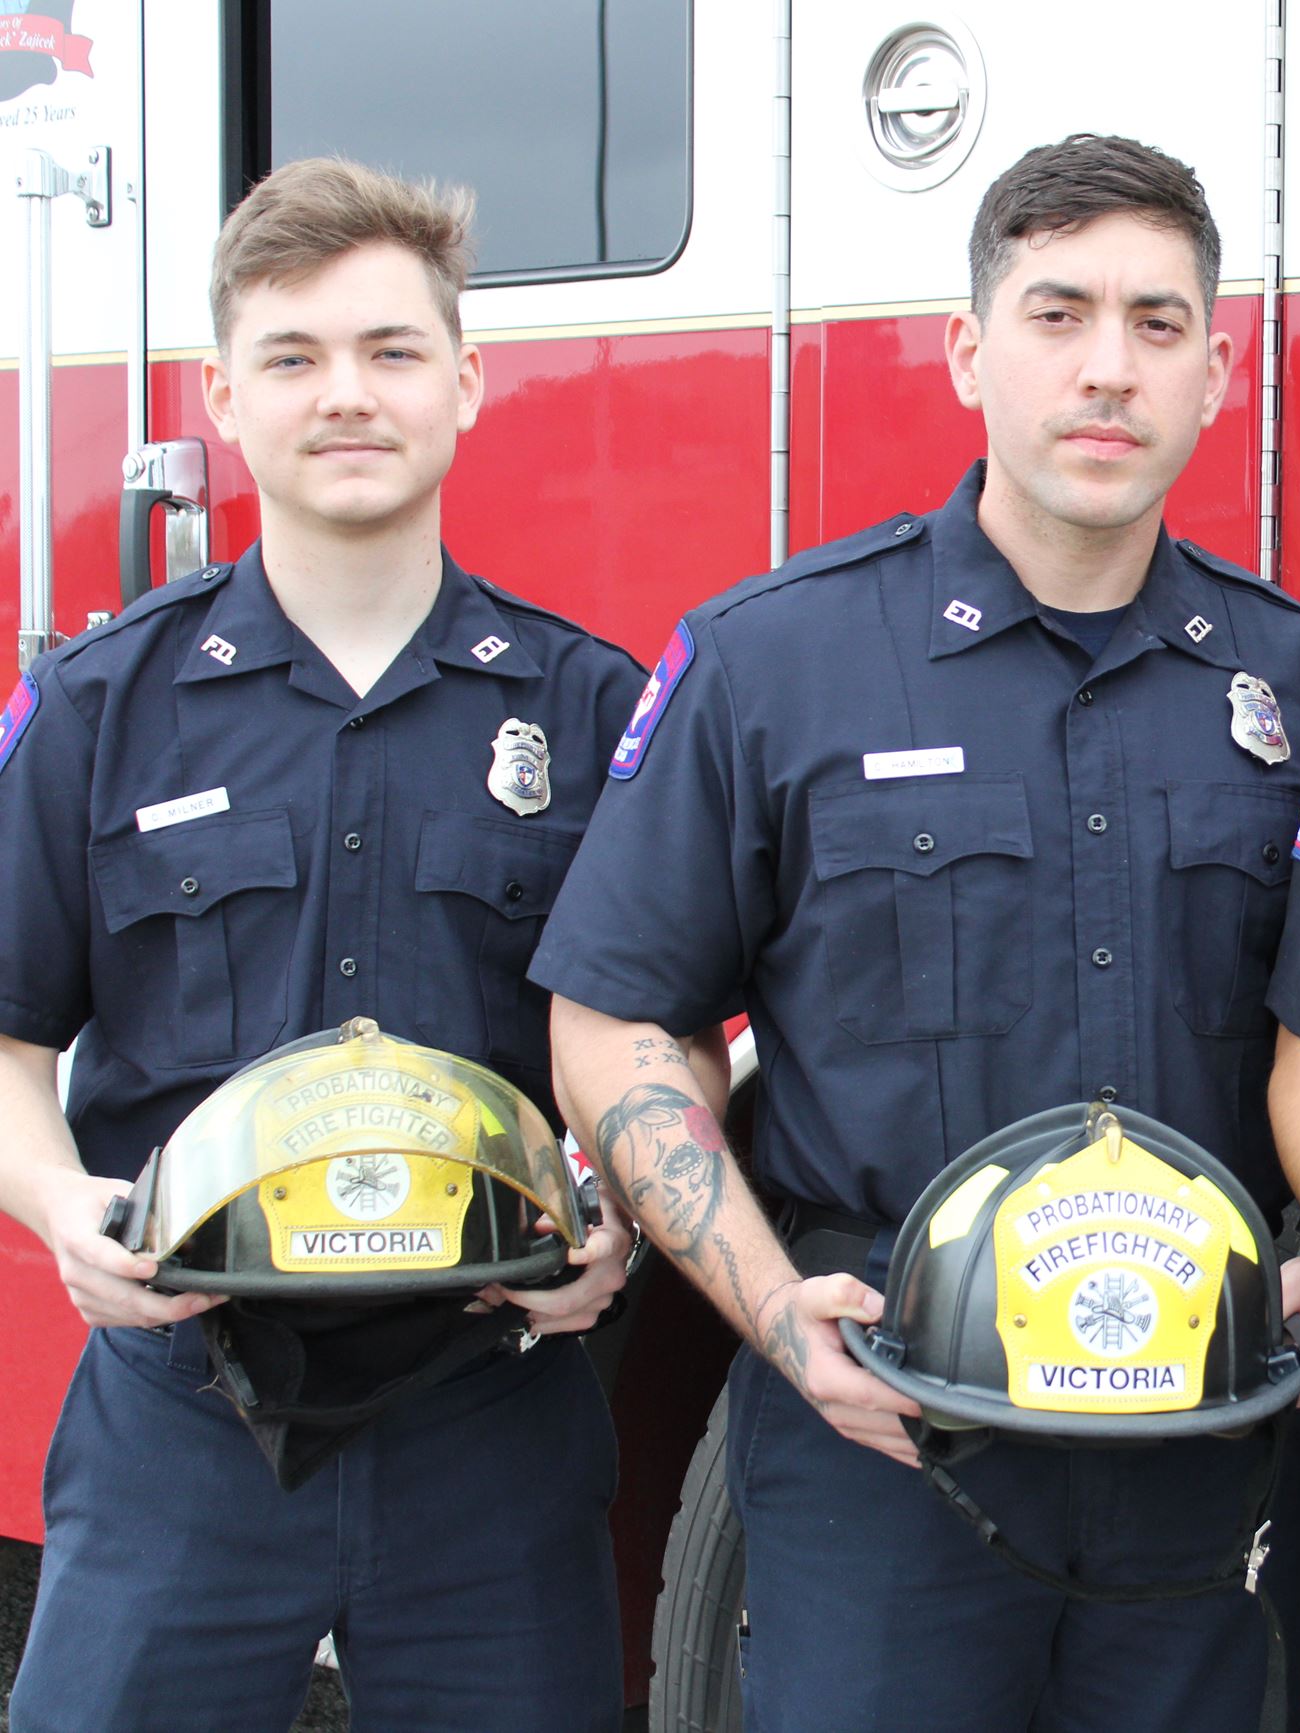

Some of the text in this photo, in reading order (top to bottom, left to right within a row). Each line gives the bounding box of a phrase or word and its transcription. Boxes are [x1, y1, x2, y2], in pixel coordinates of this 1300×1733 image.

[24, 106, 38, 124] 25
[44, 104, 76, 122] Years
[201, 634, 237, 665] FD
[168, 798, 214, 817] MILNER
[287, 1070, 450, 1111] PROBATIONARY
[284, 1106, 450, 1155] FIRE FIGHTER
[1027, 1191, 1199, 1234] PROBATIONARY
[303, 1231, 435, 1256] VICTORIA
[1026, 1231, 1198, 1285] FIREFIGHTER
[1040, 1364, 1176, 1390] VICTORIA
